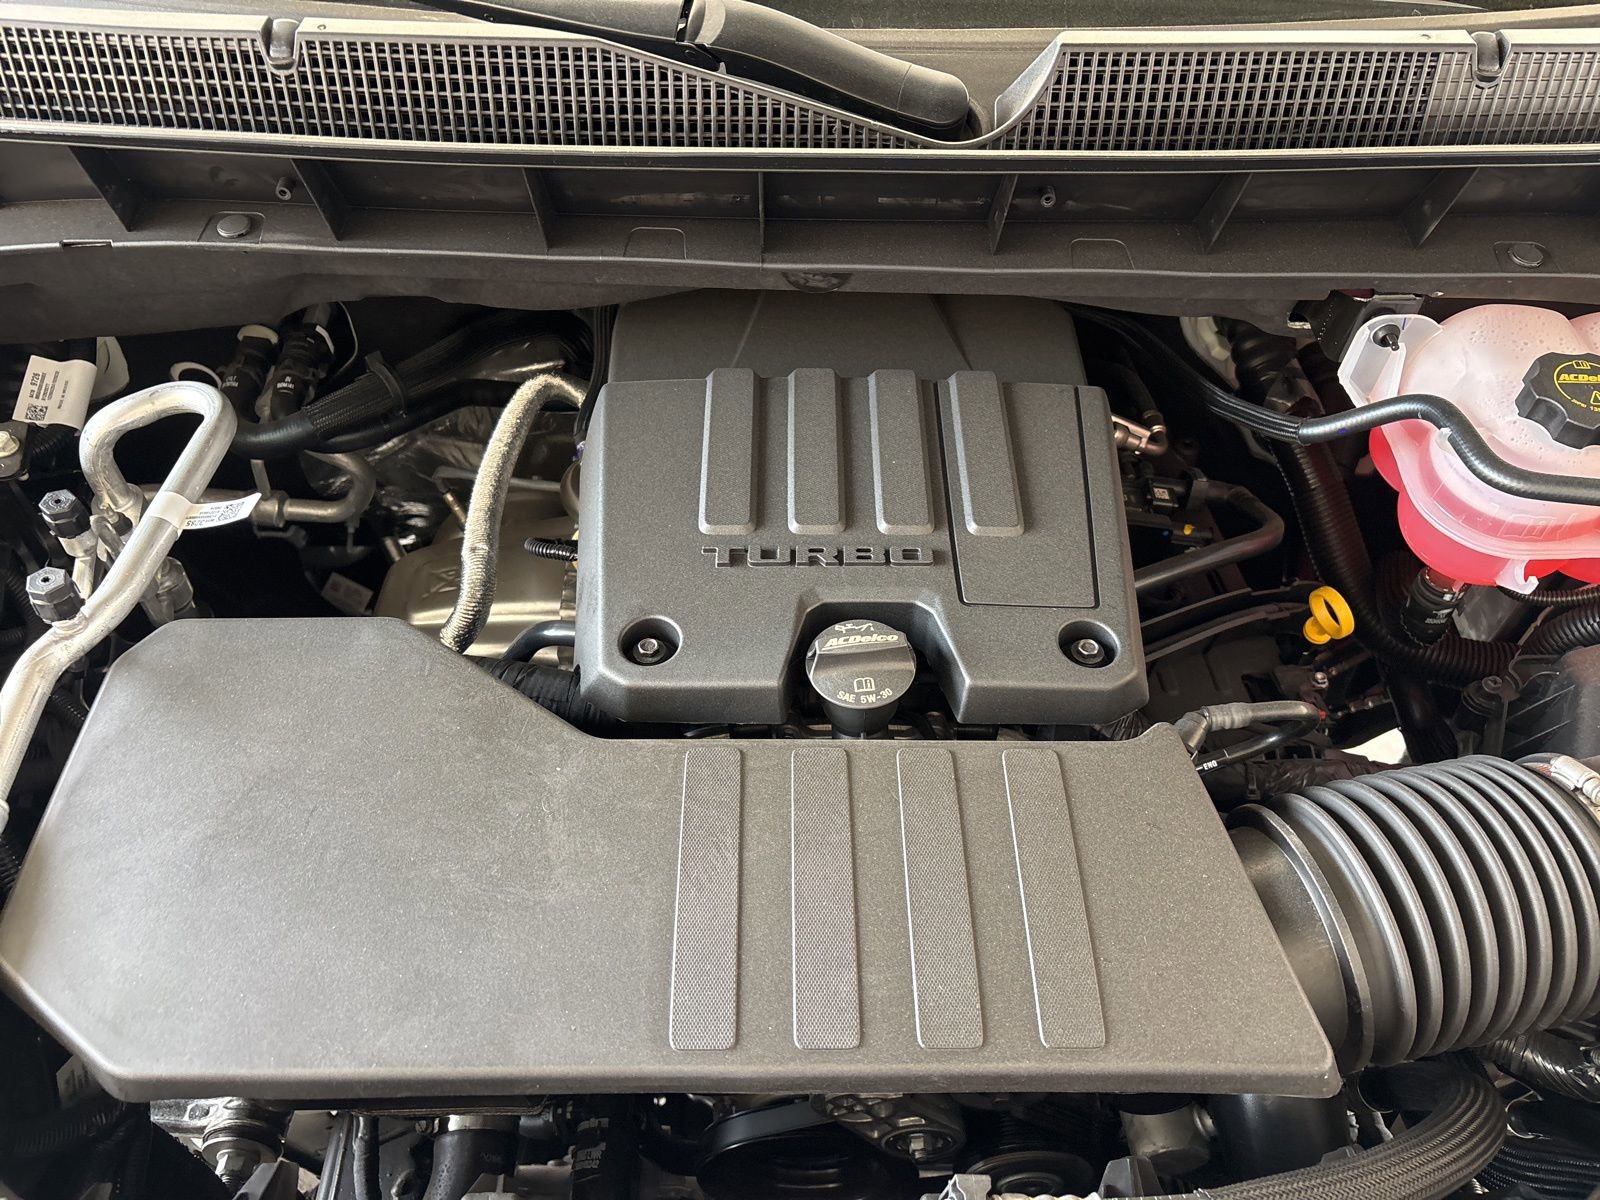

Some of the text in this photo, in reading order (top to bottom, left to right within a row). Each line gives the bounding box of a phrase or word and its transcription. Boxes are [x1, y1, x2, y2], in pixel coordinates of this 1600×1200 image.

[701, 546, 934, 568] TURBO
[823, 633, 899, 648] ACDelco
[837, 687, 893, 704] SAE 5W-30
